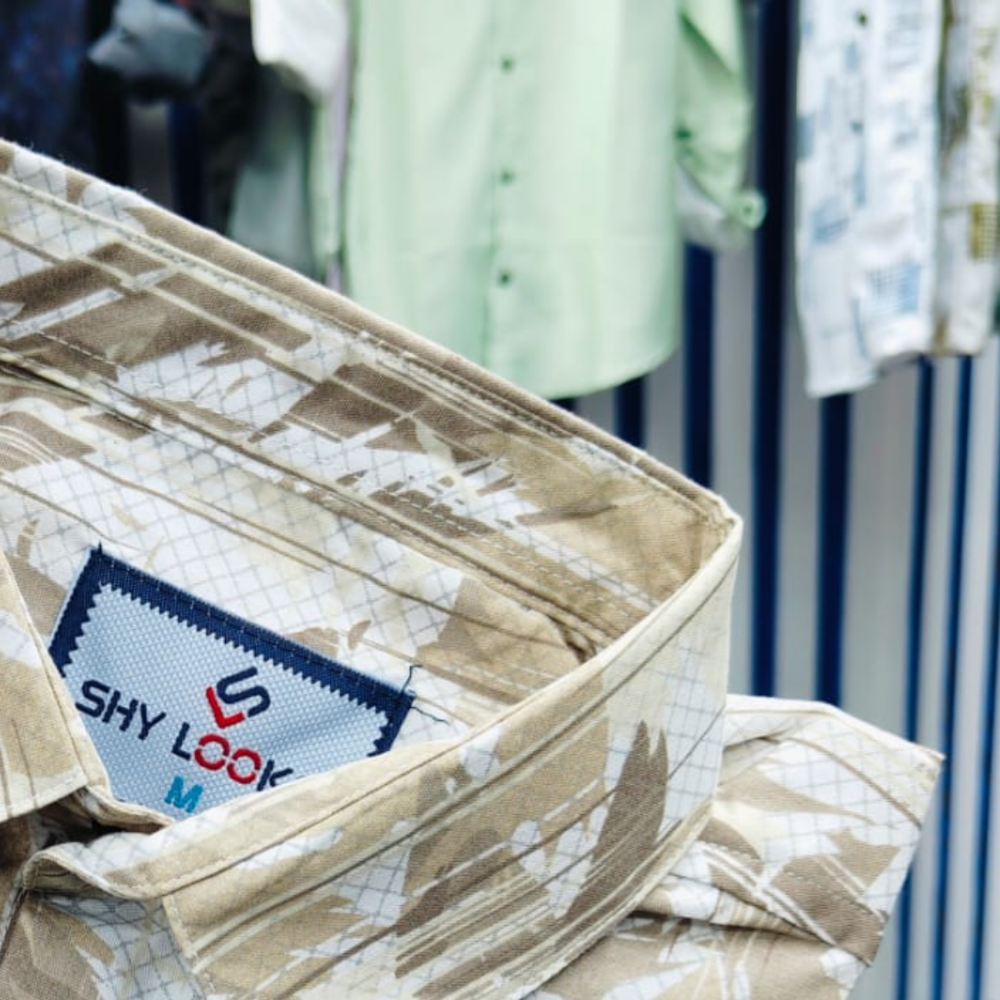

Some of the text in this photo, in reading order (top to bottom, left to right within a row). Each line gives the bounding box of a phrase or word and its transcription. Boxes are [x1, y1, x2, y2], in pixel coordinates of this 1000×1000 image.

[75, 679, 294, 792] SHY LOOK
[164, 774, 204, 814] M
